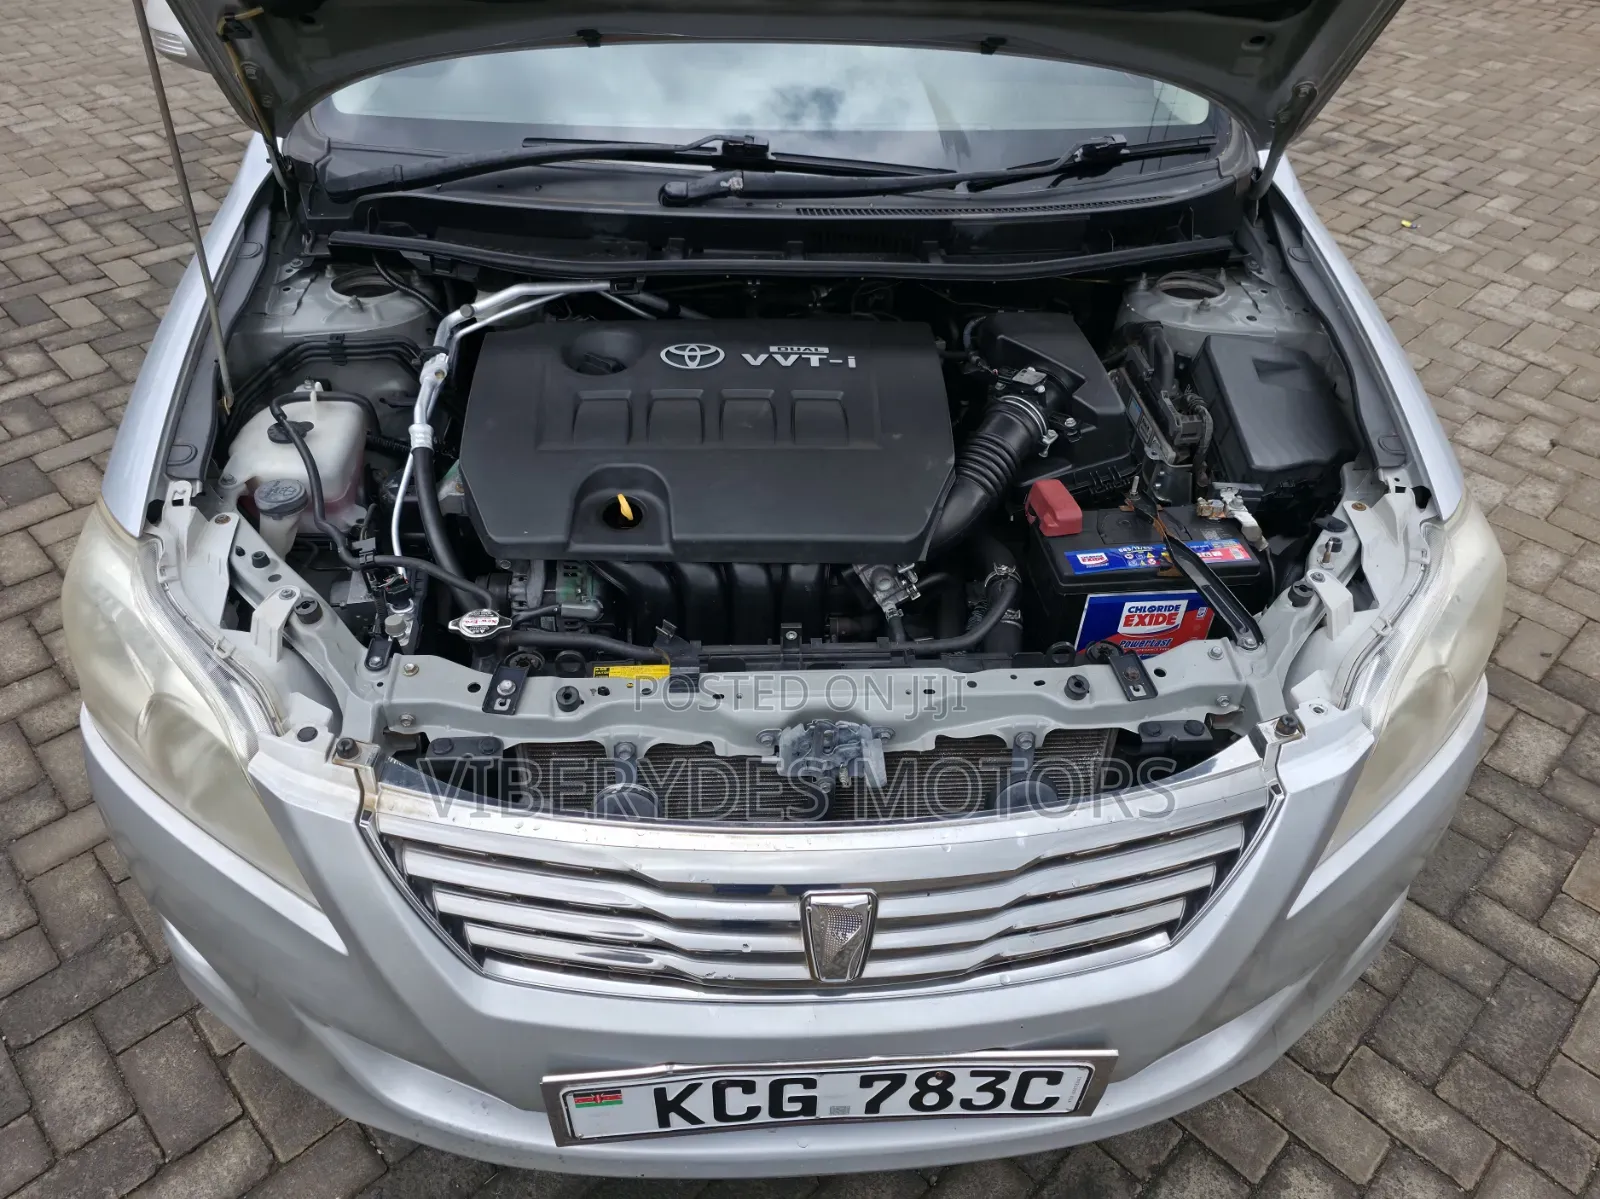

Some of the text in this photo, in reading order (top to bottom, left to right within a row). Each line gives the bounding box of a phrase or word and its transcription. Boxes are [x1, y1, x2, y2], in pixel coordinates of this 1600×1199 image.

[741, 353, 857, 368] VVT-i
[1127, 604, 1182, 614] CHLORIDE
[1123, 611, 1180, 628] EXIDE
[653, 1077, 818, 1129] KCG
[858, 1069, 1065, 1115] 783C
